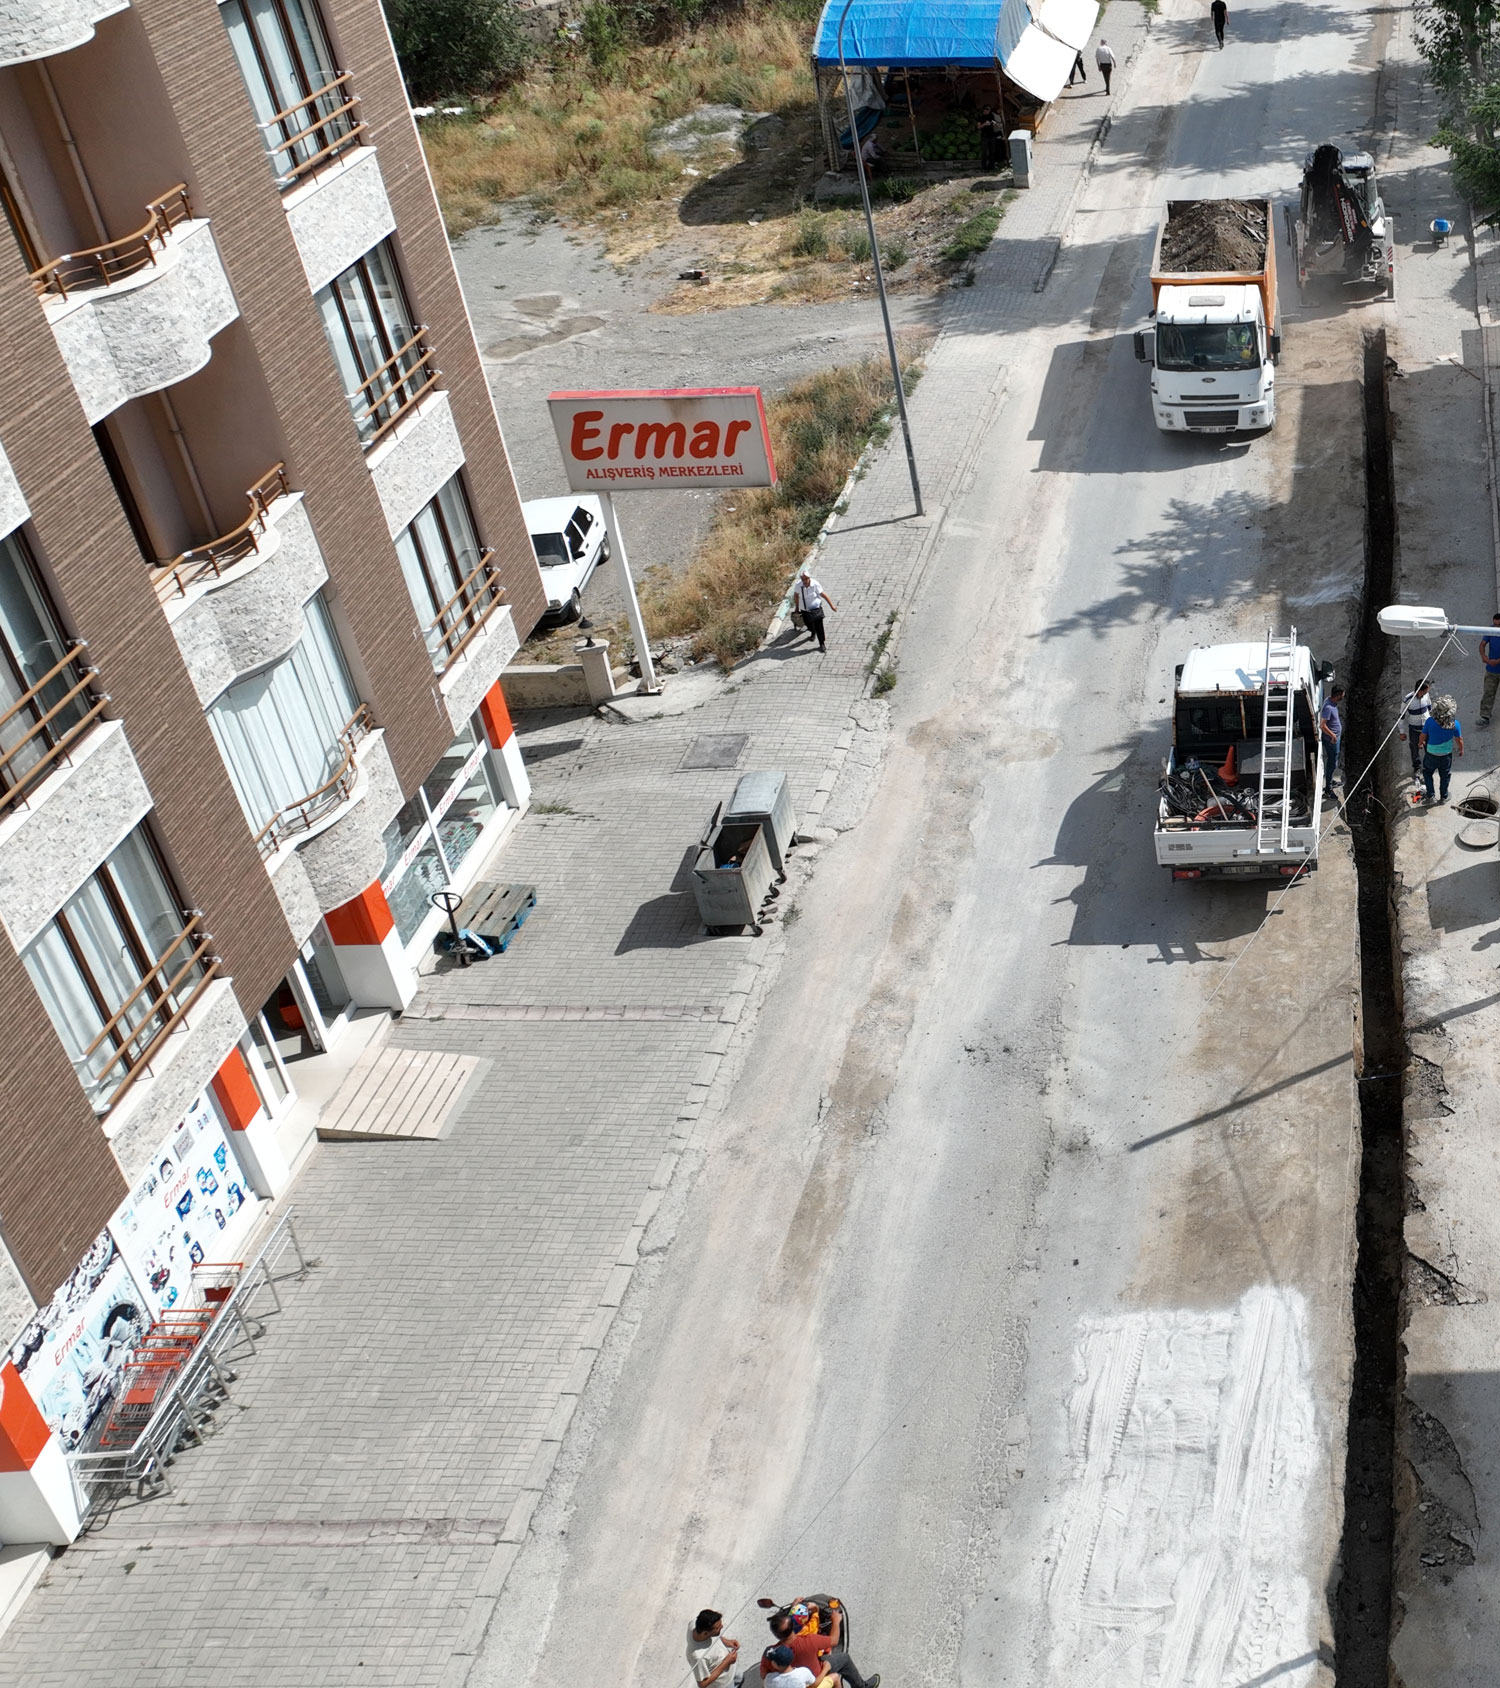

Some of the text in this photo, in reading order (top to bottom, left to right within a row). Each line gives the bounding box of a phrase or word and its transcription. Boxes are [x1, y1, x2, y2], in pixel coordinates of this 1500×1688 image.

[570, 410, 752, 461] Ermar
[586, 462, 744, 481] ALIŞVERİŞ MERKEZLERİ
[463, 750, 480, 780] Ermar
[439, 785, 456, 816] Ermar
[404, 835, 422, 867] Ermar
[163, 1166, 191, 1209] Ermar
[54, 1316, 86, 1367] Ermar
